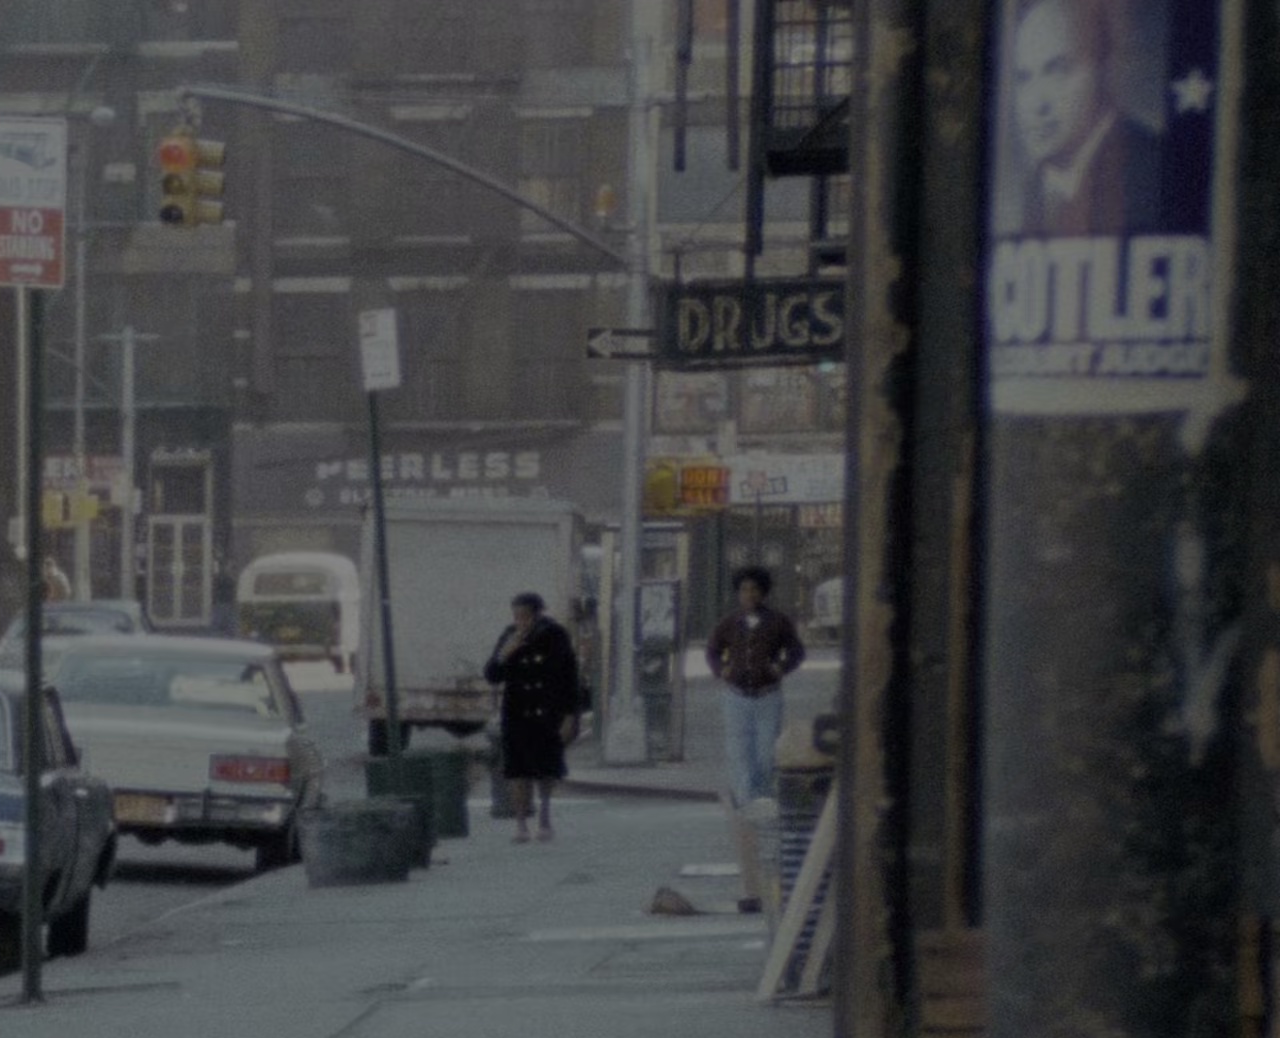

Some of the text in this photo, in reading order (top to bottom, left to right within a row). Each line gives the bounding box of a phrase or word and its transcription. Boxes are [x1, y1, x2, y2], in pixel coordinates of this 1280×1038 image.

[11, 209, 43, 234] NO
[994, 234, 1209, 343] COTLER
[678, 290, 843, 352] DRUGS
[314, 450, 541, 480] PEERLESS
